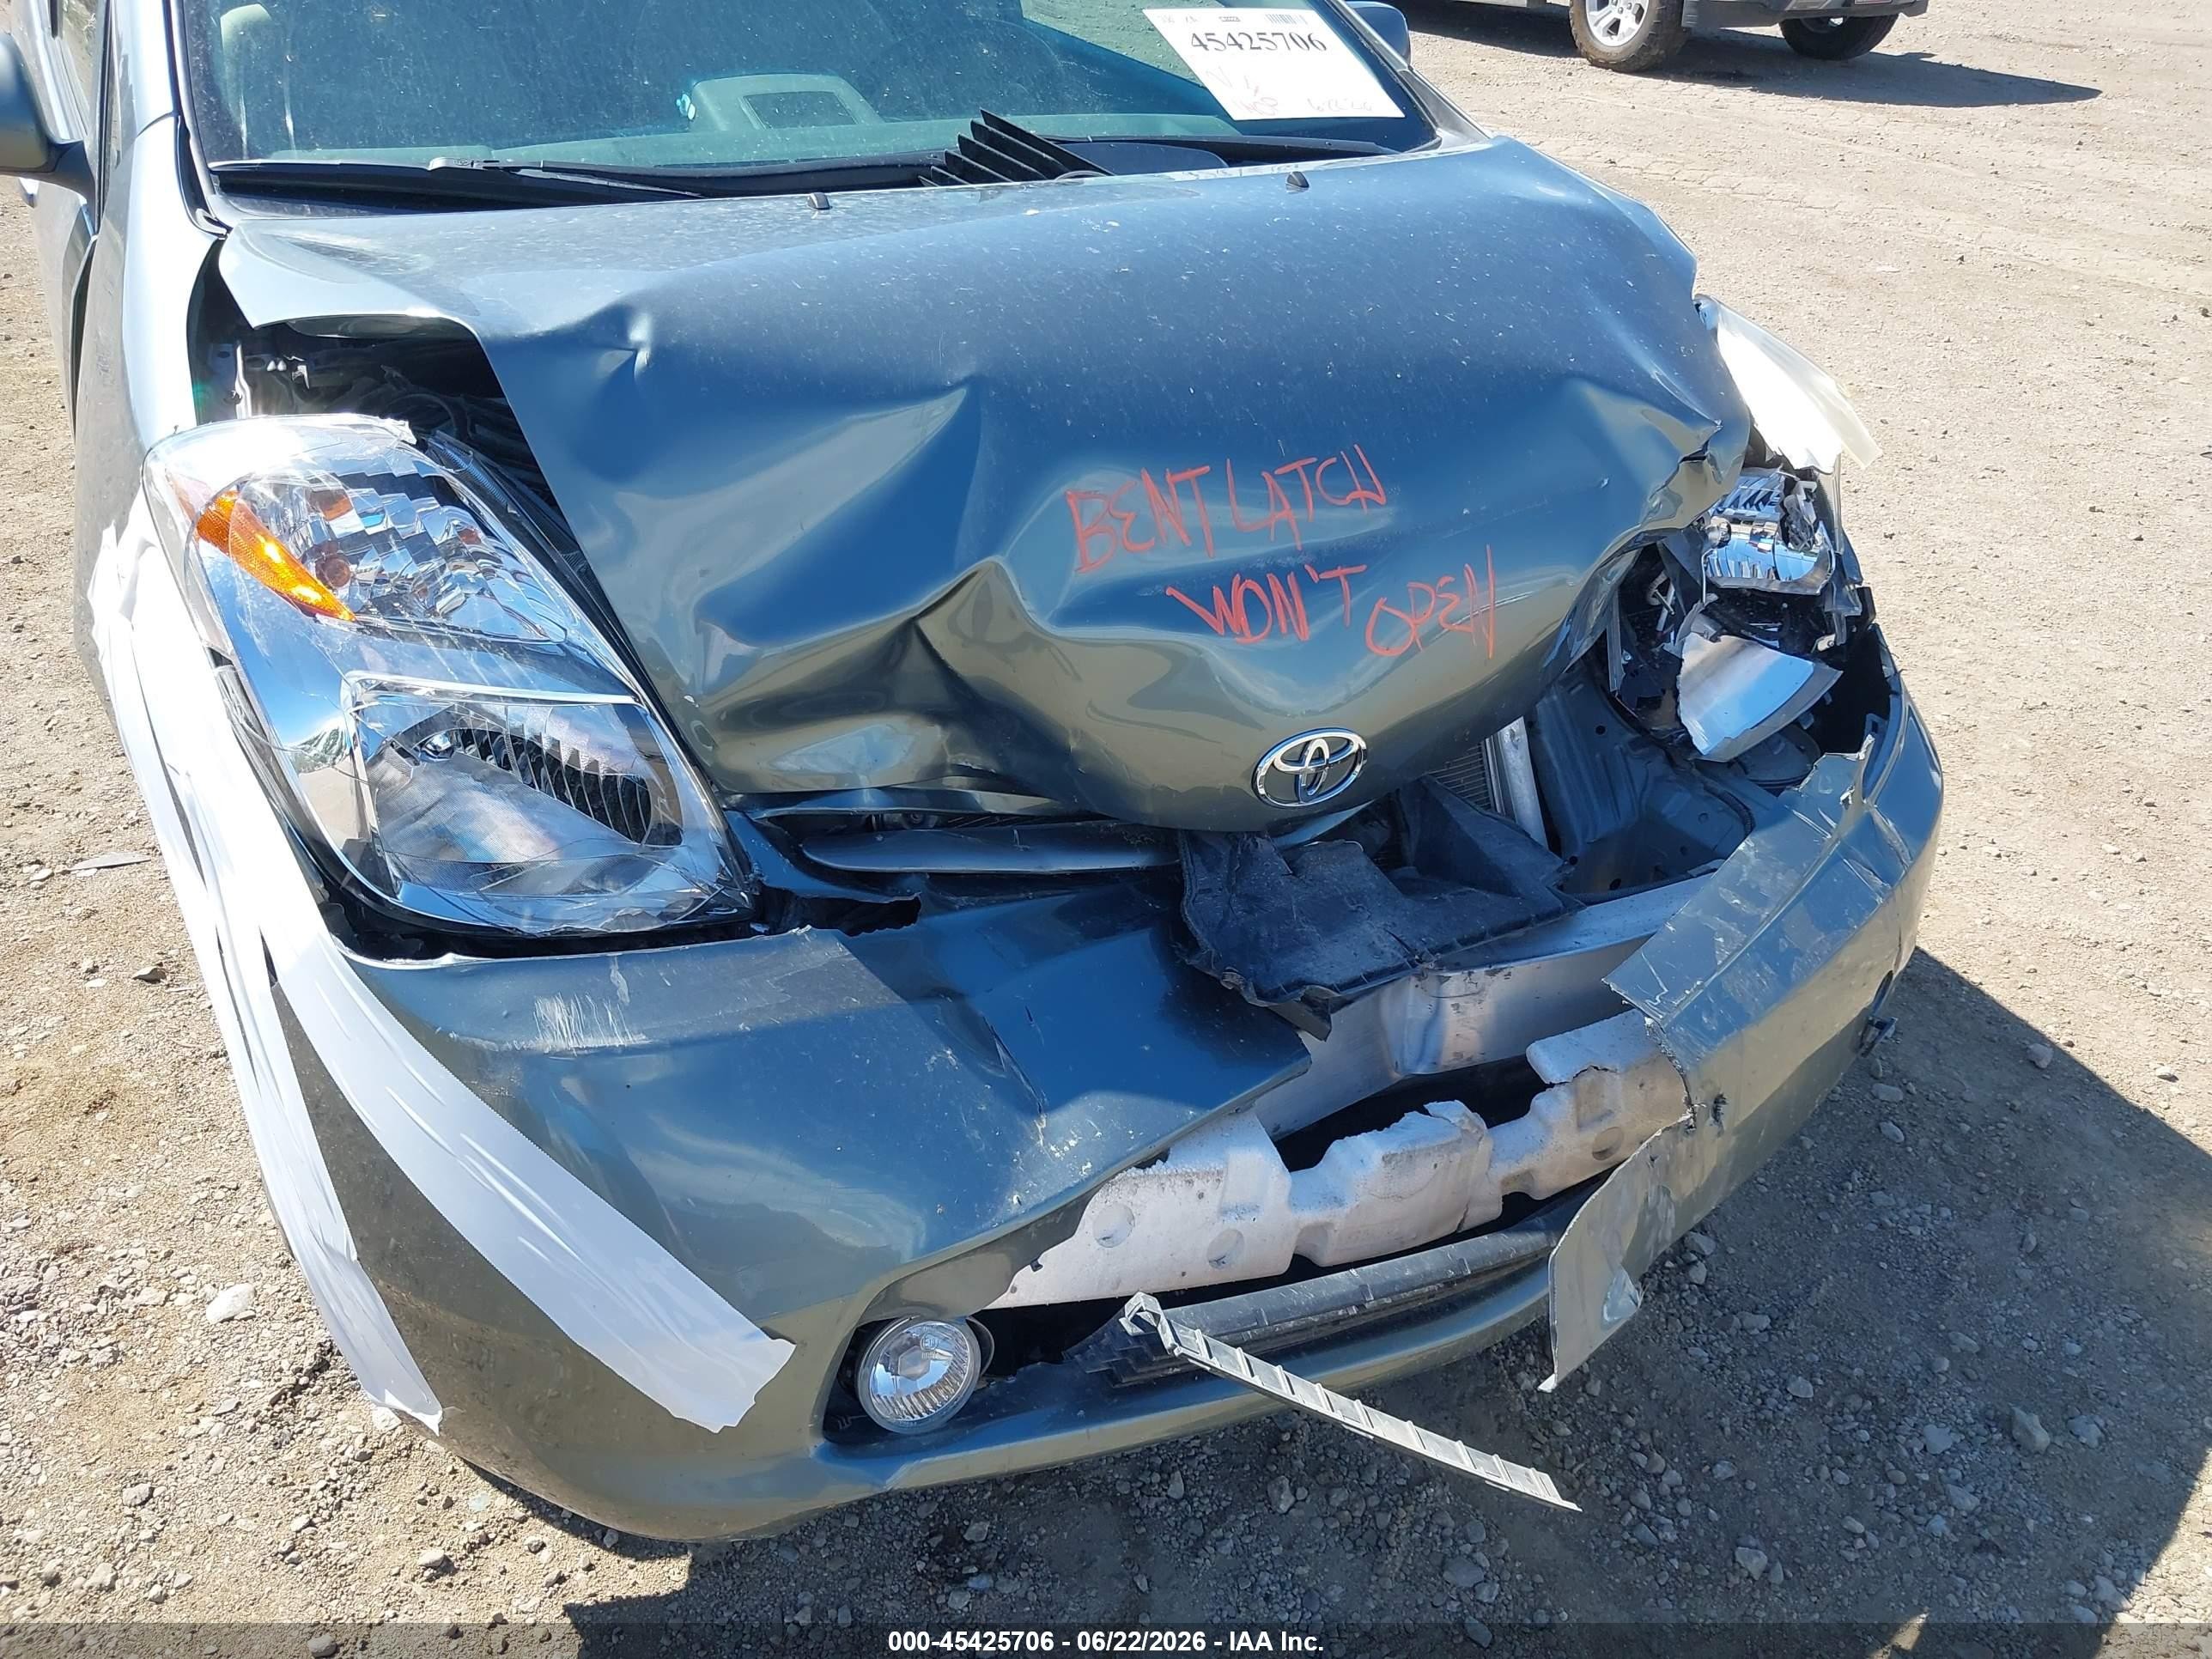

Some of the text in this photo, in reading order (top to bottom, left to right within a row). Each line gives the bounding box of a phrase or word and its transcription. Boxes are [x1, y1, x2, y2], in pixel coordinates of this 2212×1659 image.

[1191, 32, 1328, 52] 45425706
[1066, 443, 1387, 574] BENT LATCH
[1165, 544, 1497, 659] WON'T OPEN
